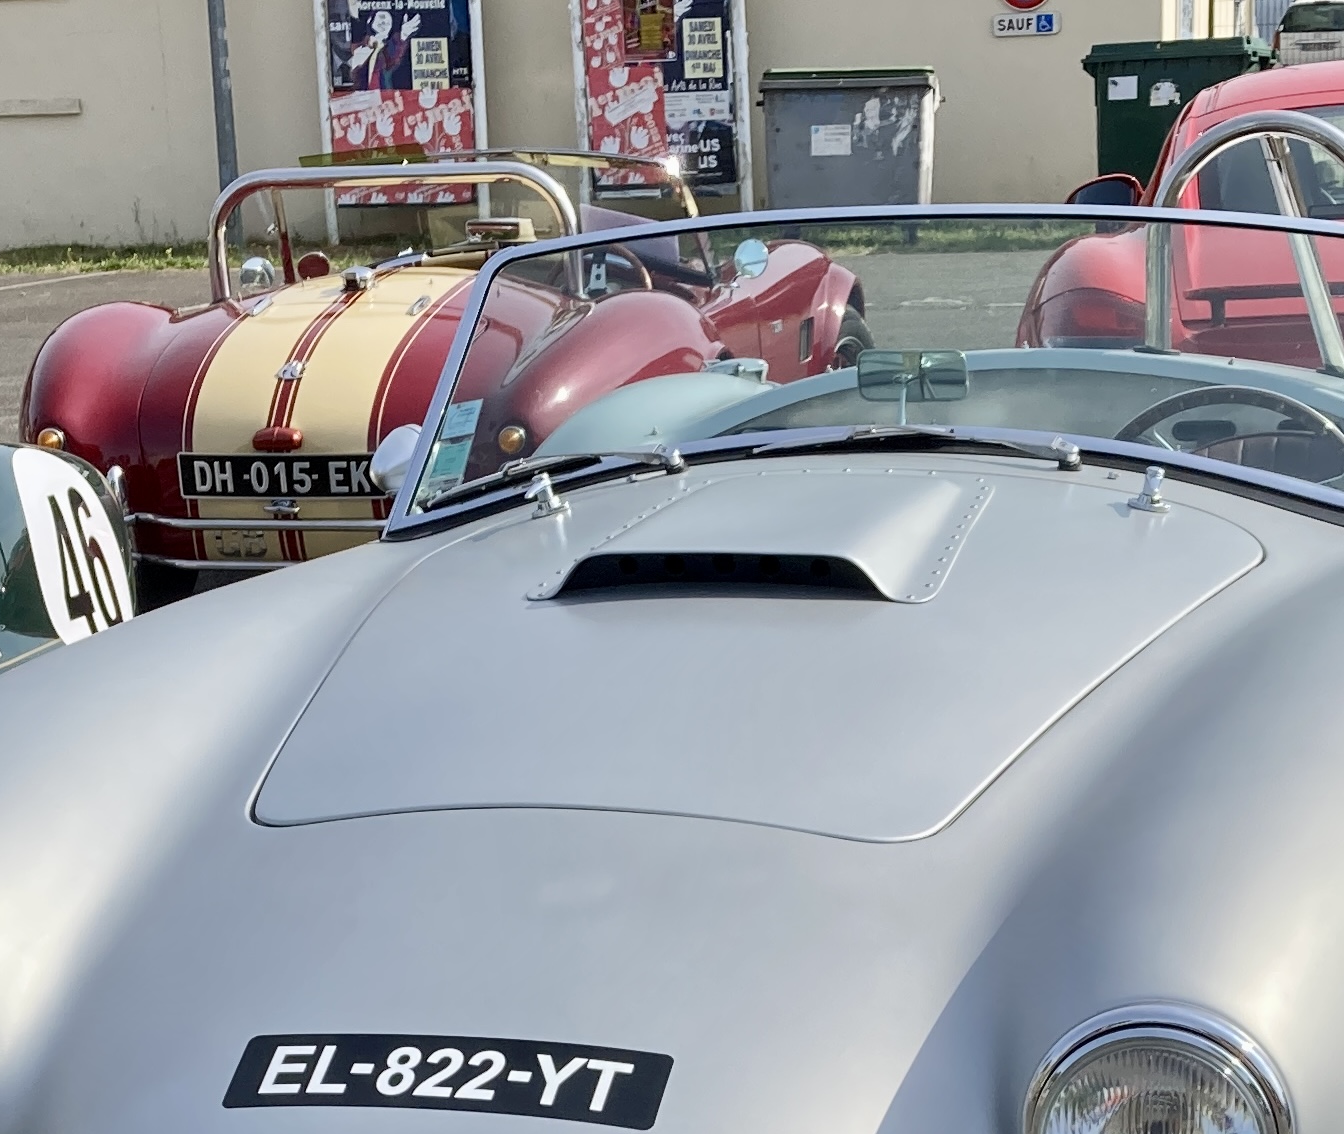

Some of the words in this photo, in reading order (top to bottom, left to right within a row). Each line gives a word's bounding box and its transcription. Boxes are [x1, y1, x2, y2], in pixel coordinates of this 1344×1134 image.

[689, 21, 715, 32] SAMEDI
[997, 18, 1033, 31] SAUF
[698, 33, 717, 45] AVRIL
[417, 40, 442, 52] SAMEDI
[425, 53, 444, 64] AVRIL
[686, 49, 722, 60] DIMANCHE
[48, 486, 123, 634] 46
[258, 1045, 634, 1112] EL-822-YT
